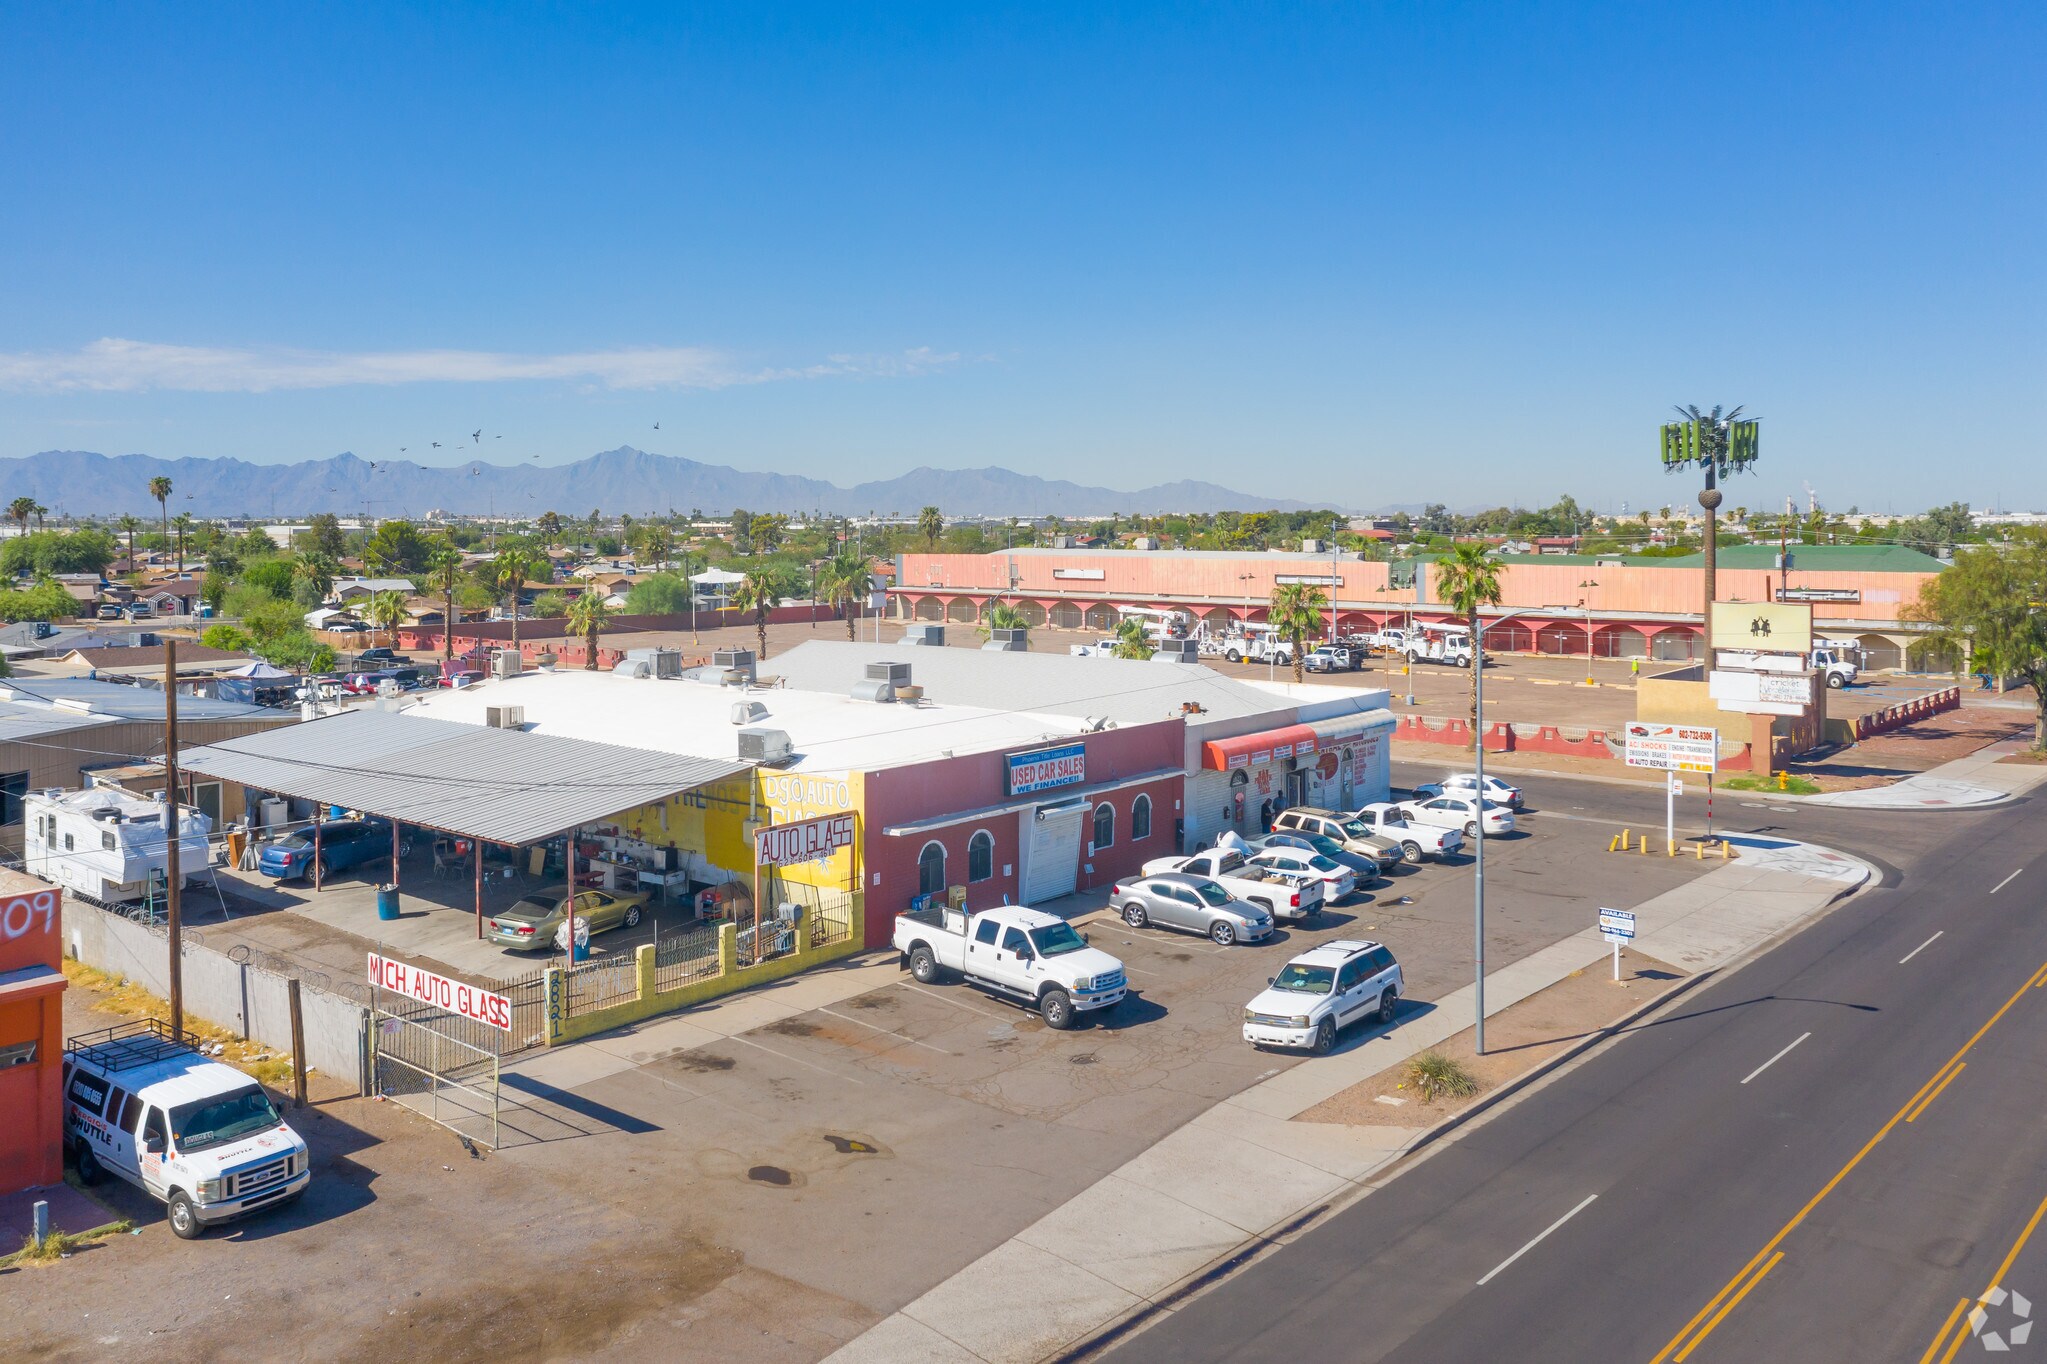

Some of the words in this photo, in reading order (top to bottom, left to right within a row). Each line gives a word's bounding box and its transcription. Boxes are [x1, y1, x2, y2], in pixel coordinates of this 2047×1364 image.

[1641, 742, 1668, 750] SHOCKS
[1066, 748, 1075, 756] LLC
[1652, 751, 1667, 759] BRAKES
[1635, 758, 1649, 766] AUTO
[1649, 760, 1668, 768] REPAIR
[1012, 765, 1035, 787] USED
[1038, 761, 1056, 781] CAR
[1058, 756, 1083, 777] SALES
[1017, 784, 1032, 793] WE
[806, 817, 852, 853] GLASS
[0, 891, 54, 939] 09
[1600, 909, 1632, 919] AVAILABLE
[414, 971, 450, 1008] AUTO
[458, 986, 509, 1028] GLASS
[69, 1113, 112, 1146] SHUTTLE
